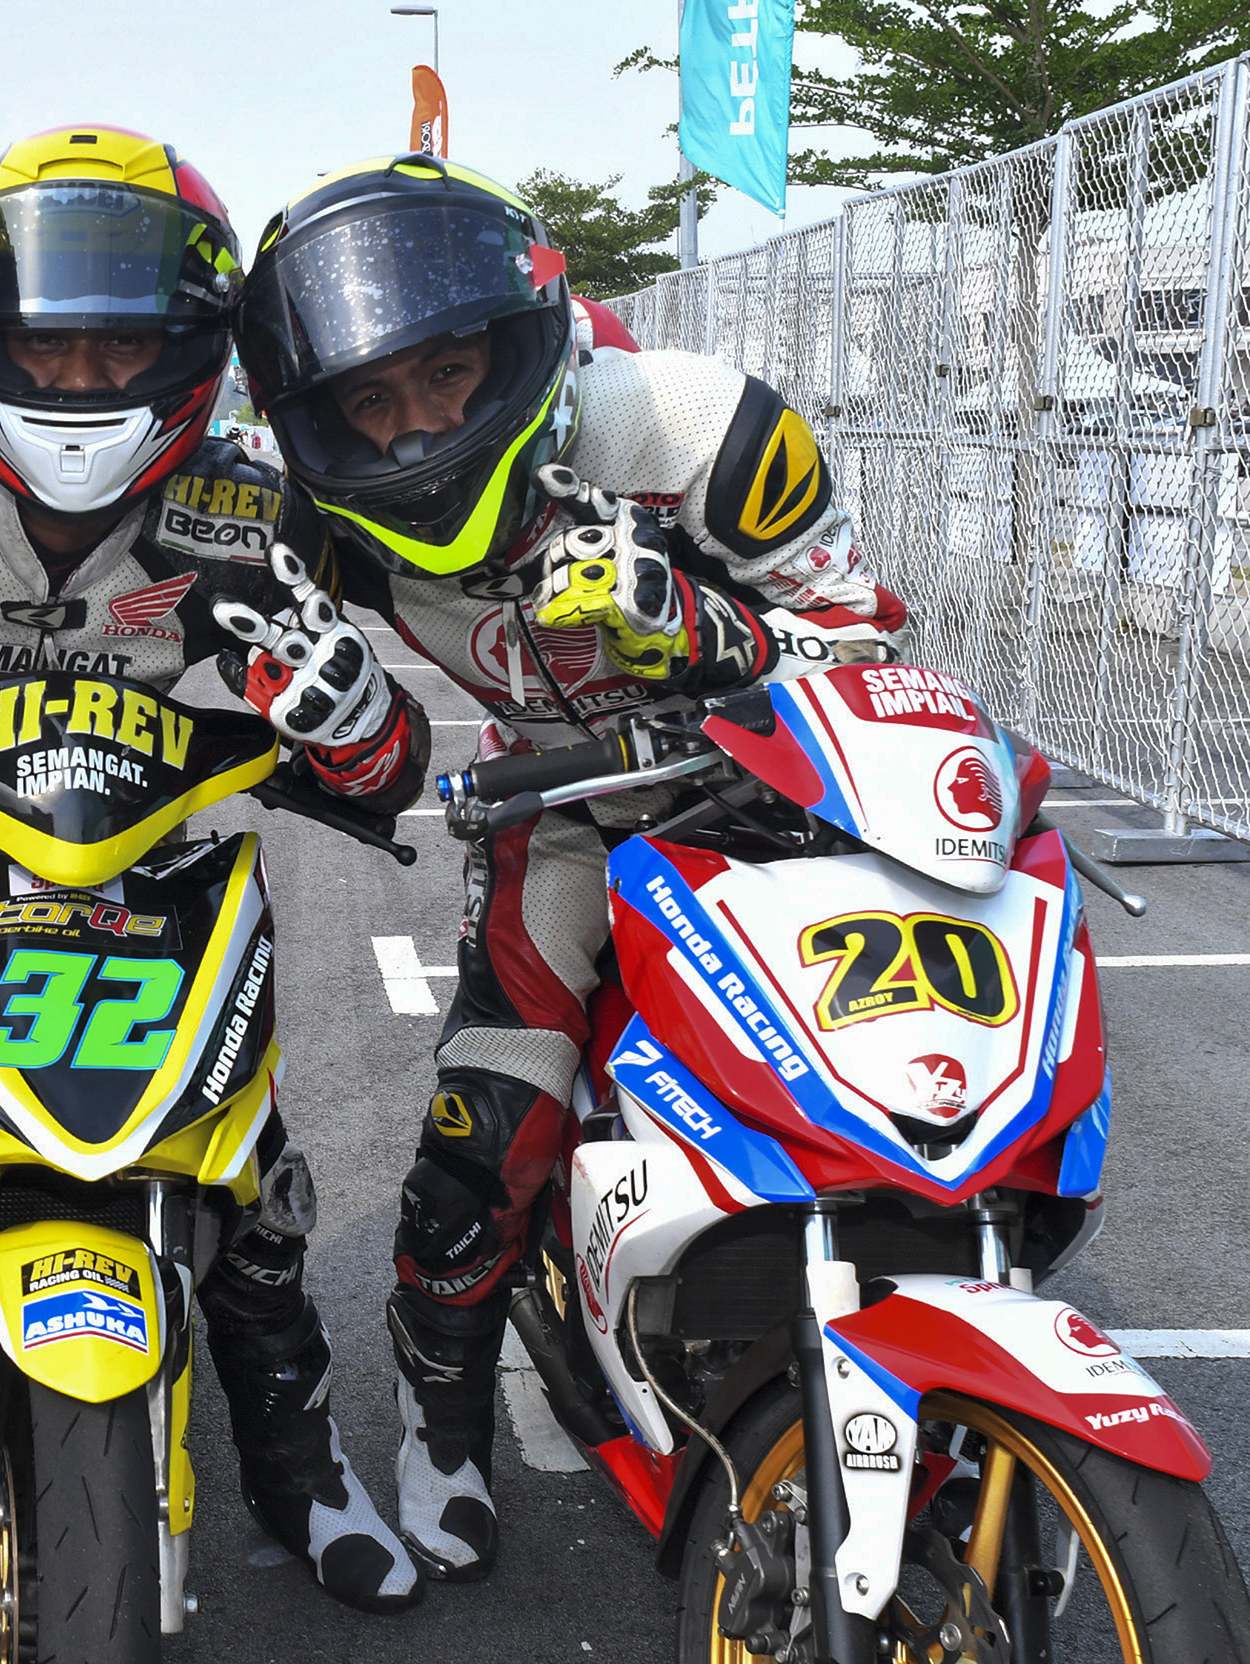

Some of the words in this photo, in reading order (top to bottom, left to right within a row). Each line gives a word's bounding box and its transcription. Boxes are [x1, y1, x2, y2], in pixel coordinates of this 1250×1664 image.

[166, 474, 281, 521] HI-REV
[624, 491, 686, 506] OTO
[101, 623, 180, 643] HONDA
[16, 745, 148, 788] SEMANGAT.
[16, 766, 112, 798] IMPIAN.
[16, 893, 56, 902] Powered
[646, 875, 723, 975] Honda
[718, 968, 810, 1083] Racing
[797, 910, 1020, 1032] 20
[848, 990, 894, 1013] AZROY
[201, 1014, 245, 1105] Honda
[234, 936, 275, 1017] Racing
[445, 1221, 482, 1260] TAICHI
[585, 1158, 650, 1293] IDEMITSU
[29, 1268, 80, 1292] RACING
[82, 1268, 105, 1284] OIL
[30, 1249, 134, 1284] HI-REV
[24, 1311, 146, 1344] ASHUKA
[1084, 1406, 1149, 1431] Yuzy
[846, 1453, 899, 1470] AIRBRUSH
